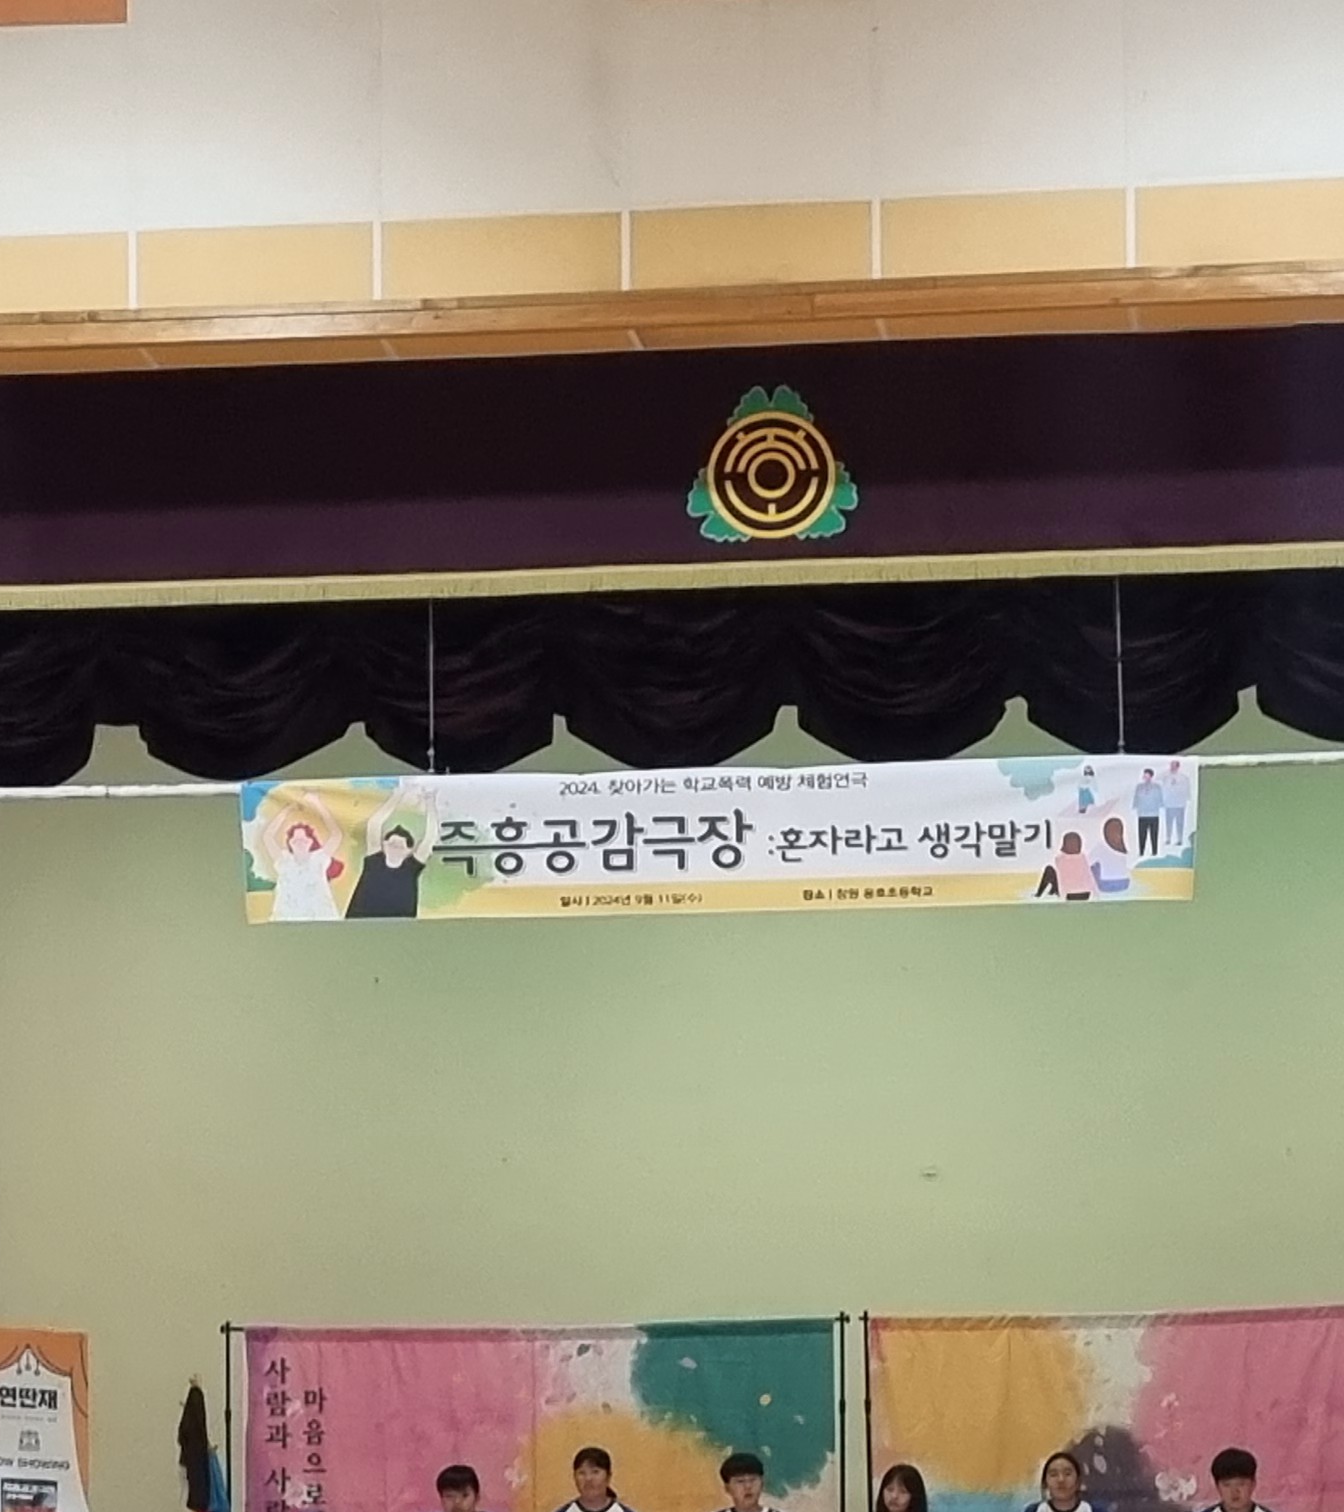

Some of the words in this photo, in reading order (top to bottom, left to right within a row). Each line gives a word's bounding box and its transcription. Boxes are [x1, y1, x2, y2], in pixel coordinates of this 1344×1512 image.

[608, 777, 677, 796] 찾아가는
[683, 775, 752, 793] 학교폭력
[757, 774, 792, 791] 예방
[797, 771, 869, 790] 체험연극
[432, 808, 754, 876] 즉흥공감극장
[917, 819, 1053, 859] 생각말기
[264, 1357, 293, 1450] 사람과
[301, 1386, 328, 1505] 마음으로
